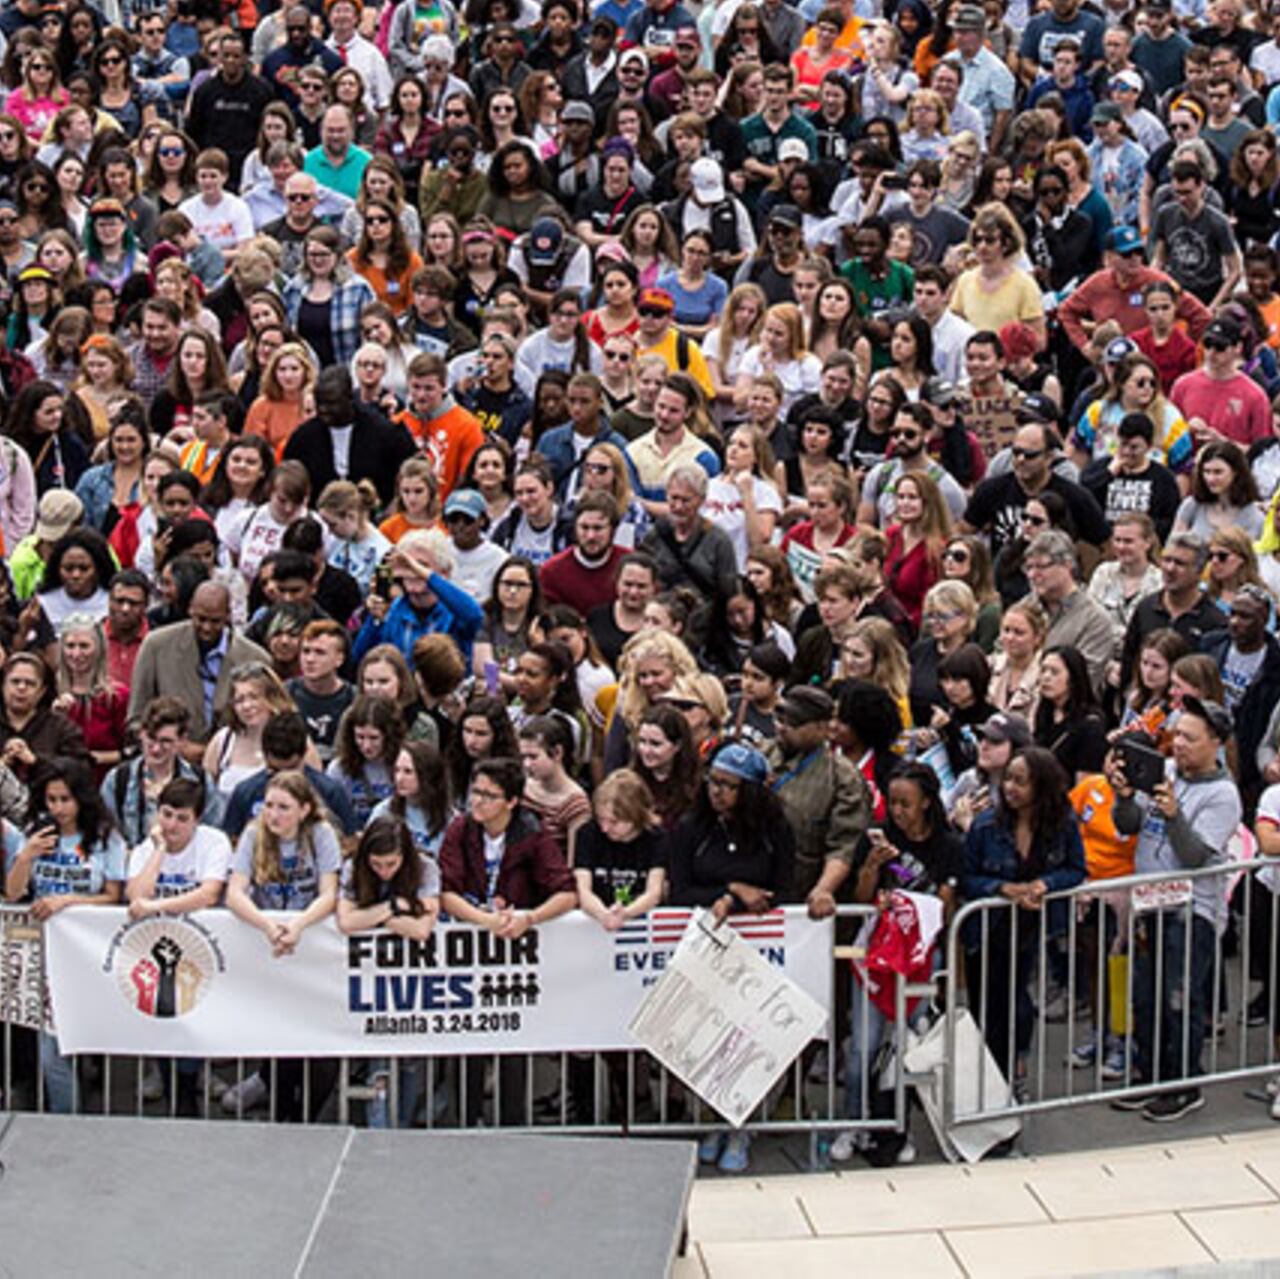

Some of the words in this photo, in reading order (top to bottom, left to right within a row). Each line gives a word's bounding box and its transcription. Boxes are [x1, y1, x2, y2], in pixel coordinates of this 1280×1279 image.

[1108, 479, 1152, 494] BLACK
[1107, 494, 1151, 511] LIVES
[348, 931, 438, 969] FOR
[446, 928, 540, 966] OUR
[348, 974, 475, 1013] LIVES
[365, 1015, 429, 1035] Atlanta
[433, 1011, 521, 1034] 3.24.2018
